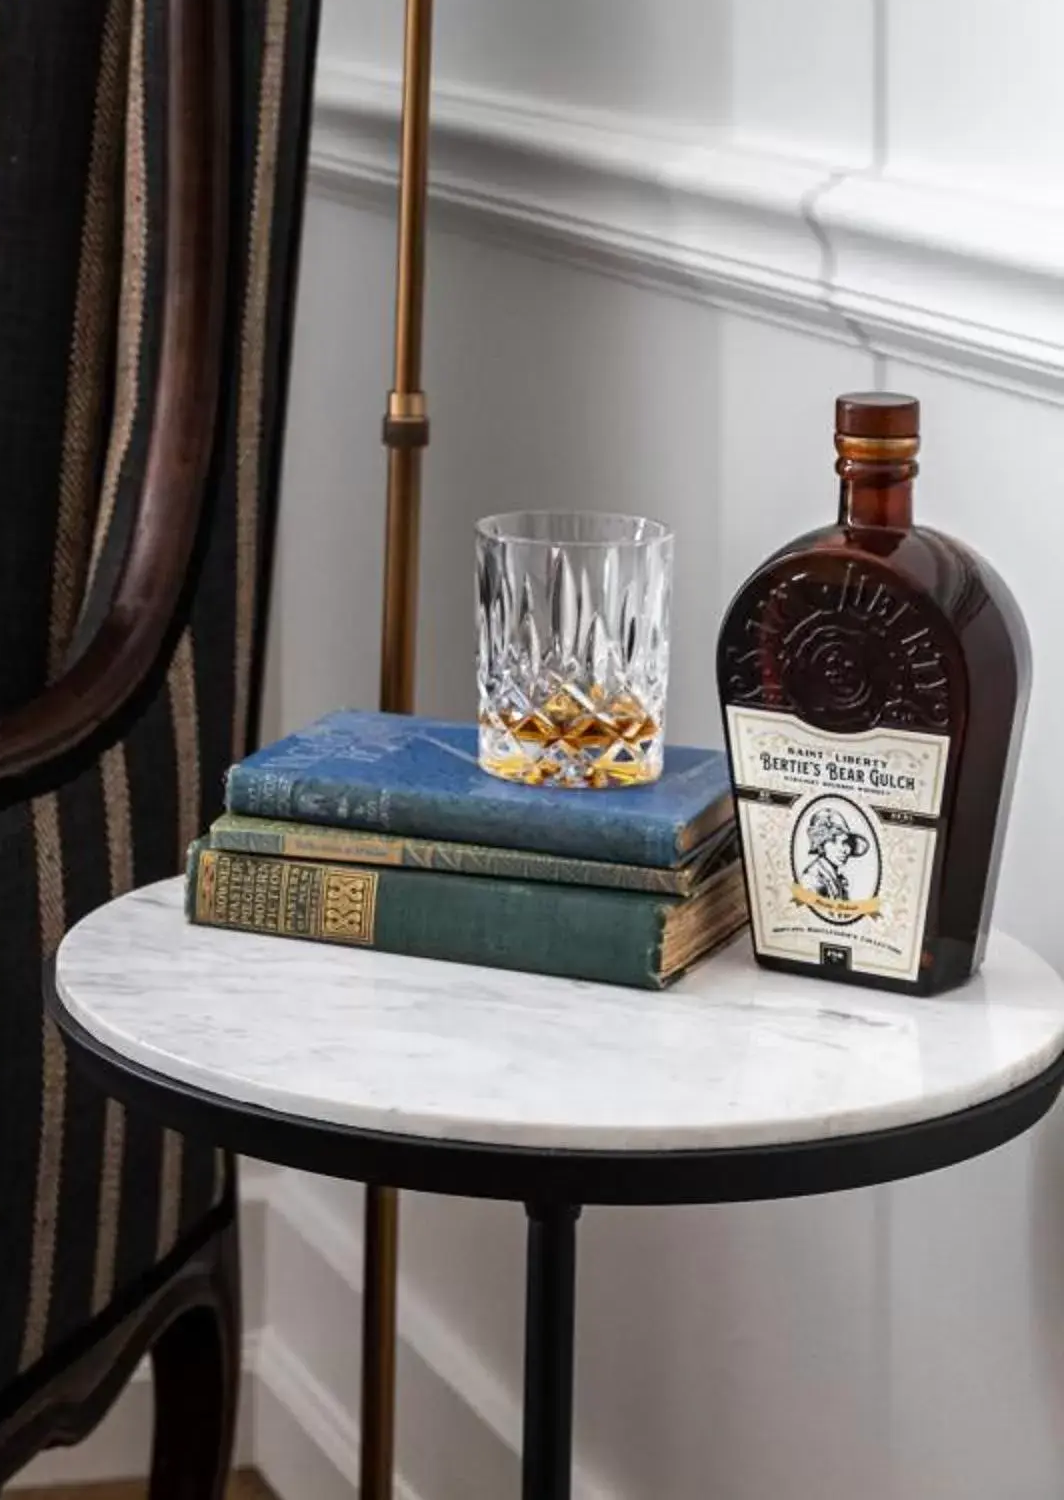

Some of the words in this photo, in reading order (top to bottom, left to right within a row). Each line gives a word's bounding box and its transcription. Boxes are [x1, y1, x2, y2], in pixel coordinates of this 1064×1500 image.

[788, 747, 823, 759] SAINT
[836, 754, 888, 768] LIBERTY
[825, 762, 865, 782] BEAR
[869, 769, 916, 791] GULCH
